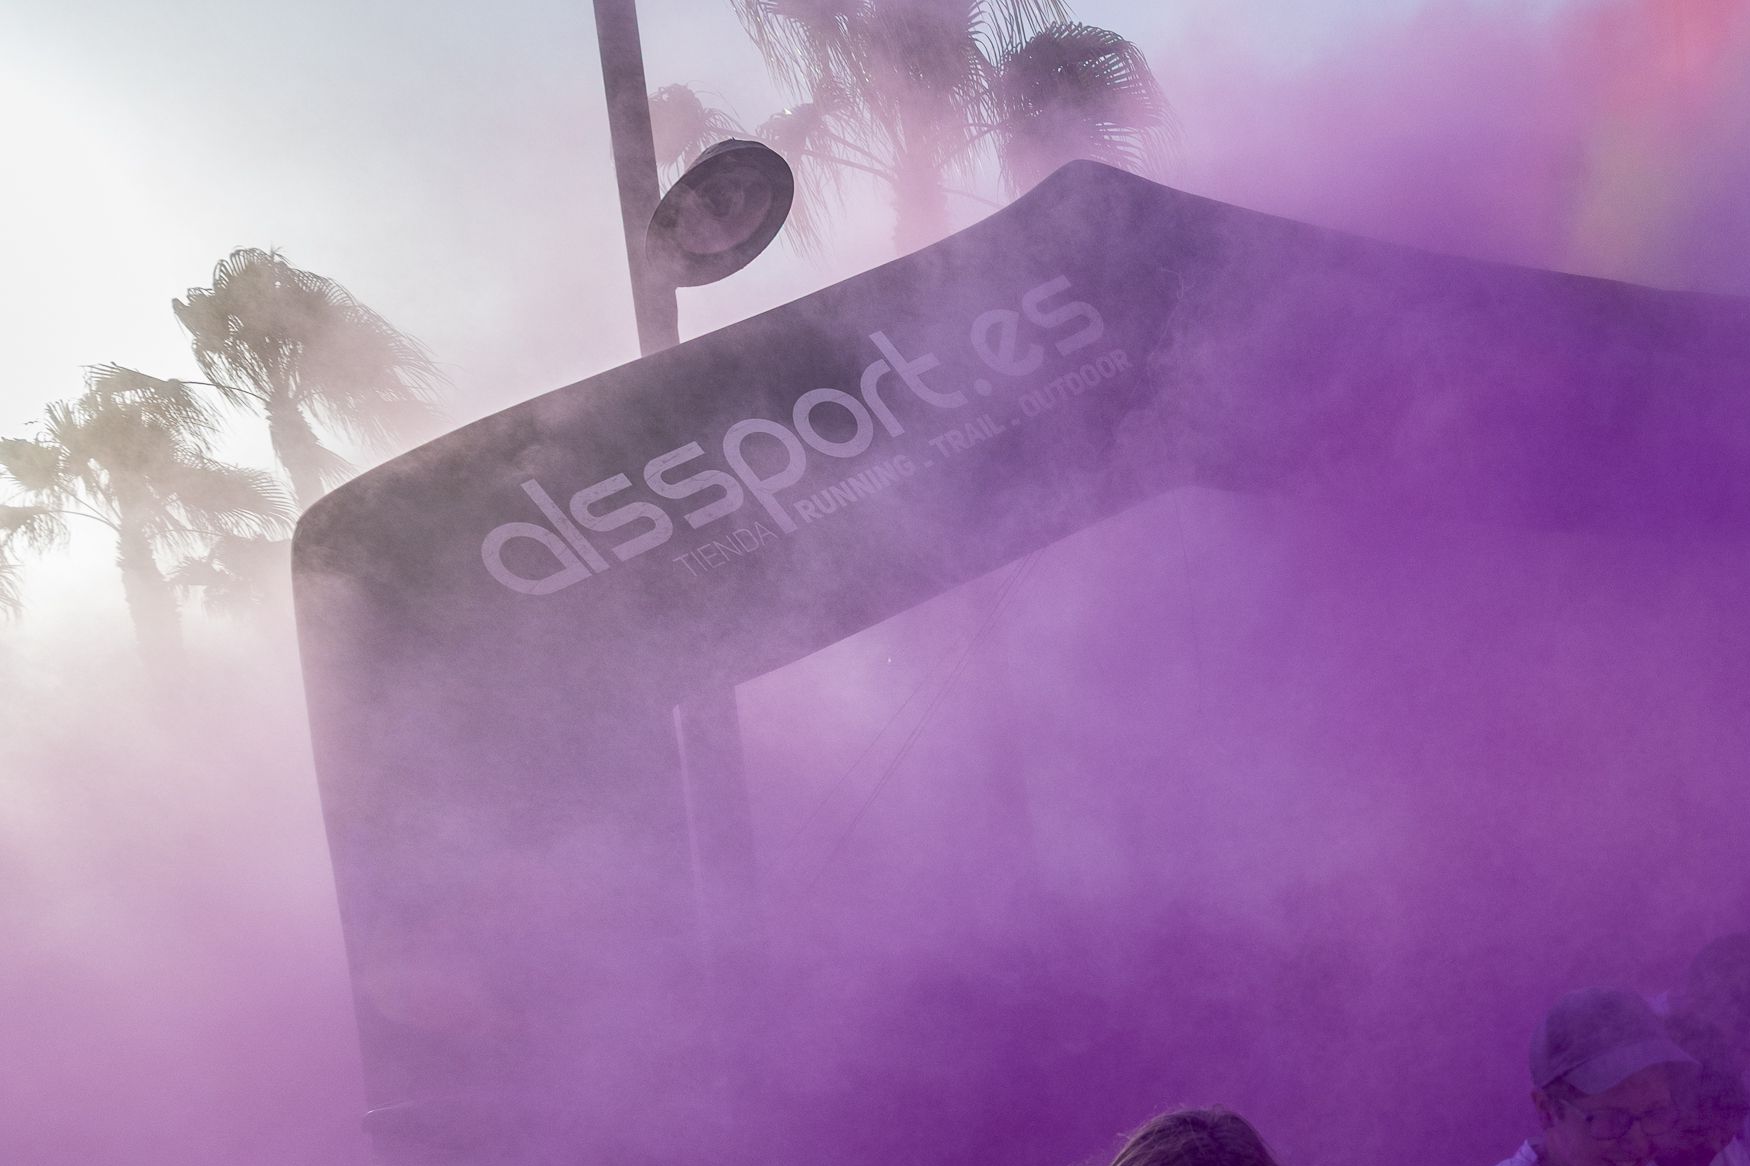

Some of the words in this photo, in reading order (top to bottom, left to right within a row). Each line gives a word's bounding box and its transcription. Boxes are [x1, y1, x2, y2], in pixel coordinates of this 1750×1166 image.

[481, 274, 1104, 596] alssport.es
[673, 520, 779, 578] TIENDA
[793, 454, 917, 524] RUNNING
[928, 413, 1007, 459] TRAIL
[1017, 348, 1133, 419] OUTDOOR
